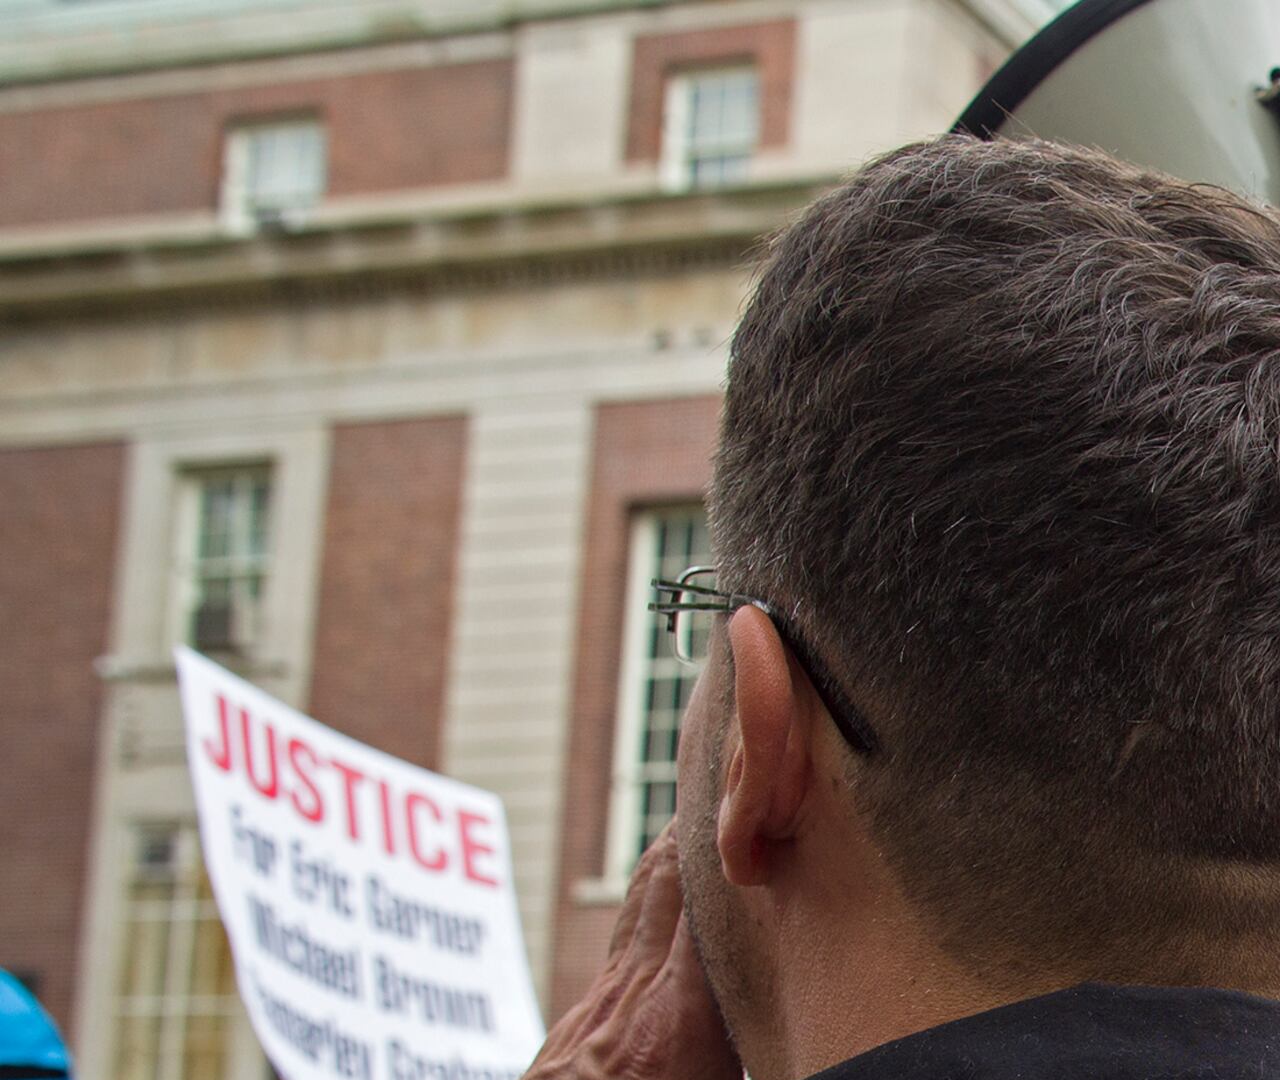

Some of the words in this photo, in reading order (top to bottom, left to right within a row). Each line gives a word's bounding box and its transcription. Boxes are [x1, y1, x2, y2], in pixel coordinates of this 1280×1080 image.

[202, 692, 501, 889] JUSTICE
[230, 803, 283, 878] For
[290, 838, 353, 919] Eric
[366, 870, 488, 957] Garner
[247, 891, 358, 1000] Michael
[374, 951, 496, 1034] Brown
